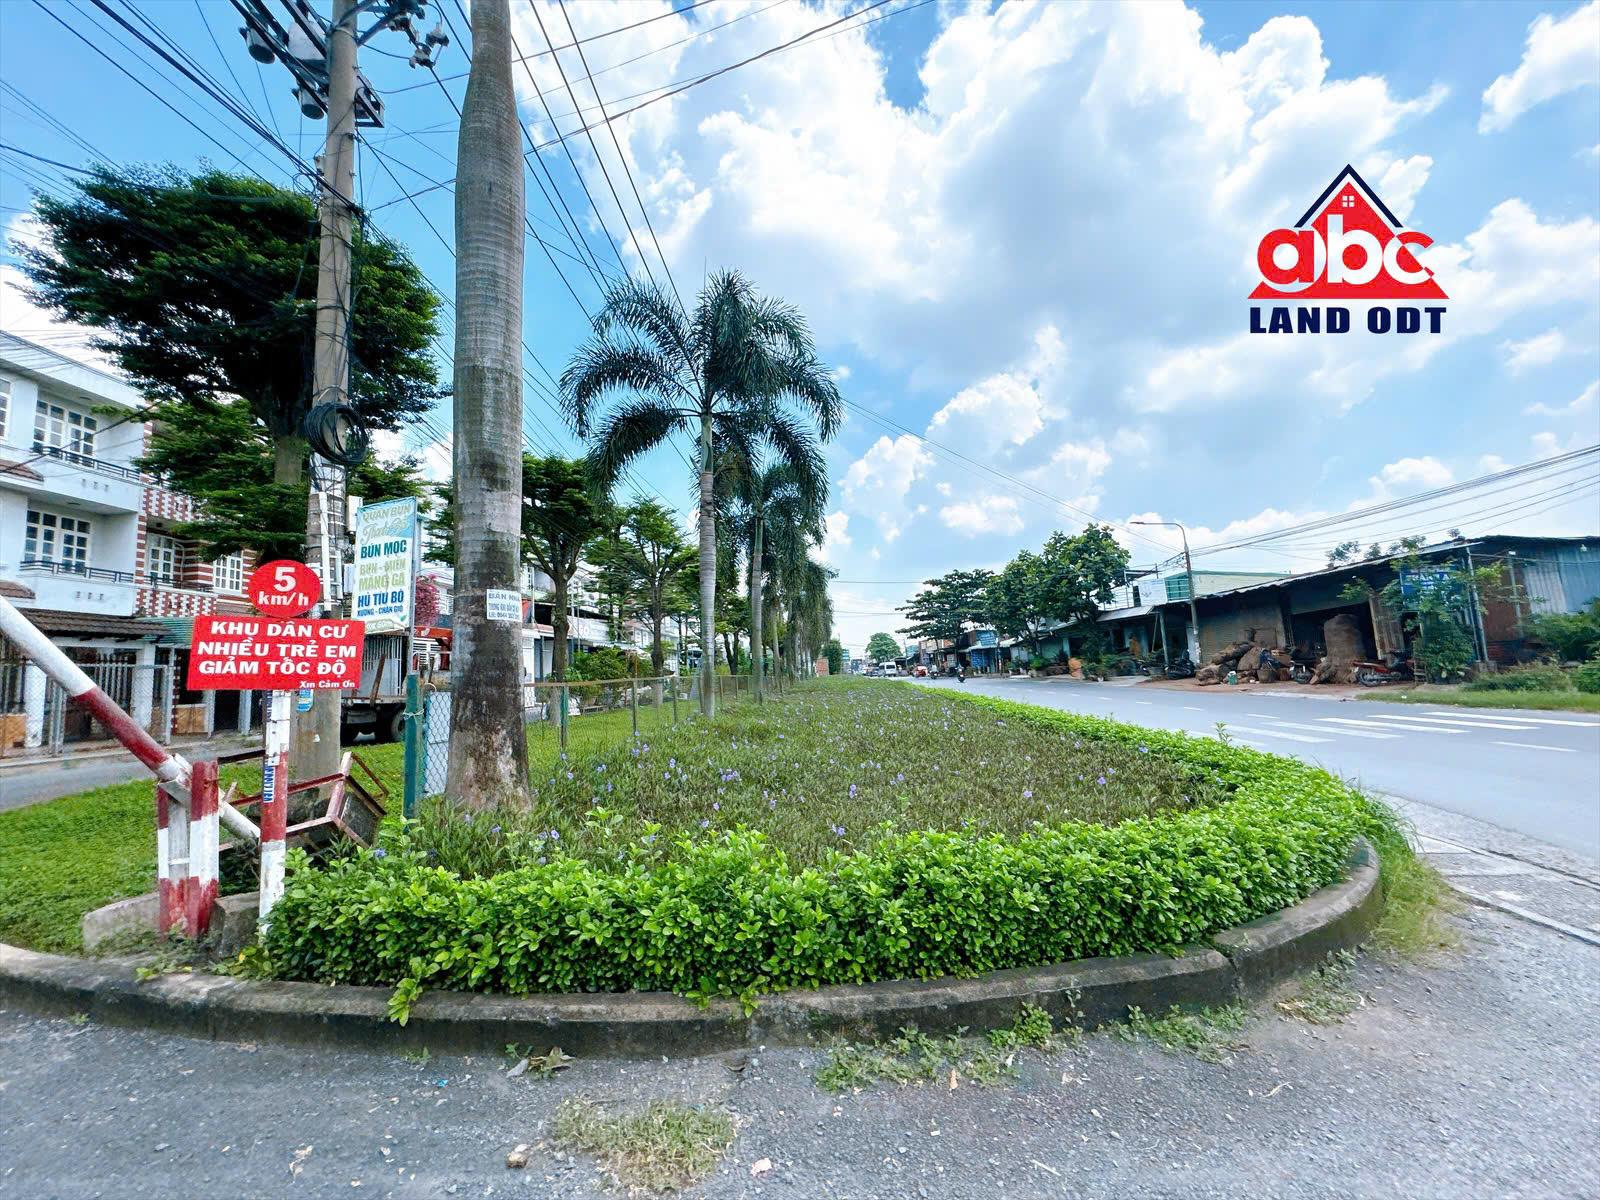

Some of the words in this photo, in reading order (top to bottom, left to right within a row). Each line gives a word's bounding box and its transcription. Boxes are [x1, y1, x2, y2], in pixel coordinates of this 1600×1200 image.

[361, 542, 382, 559] BÚN
[273, 566, 297, 592] 5
[258, 592, 309, 606] km/h
[211, 621, 259, 636] KHU
[266, 620, 313, 637] DÂN
[319, 624, 350, 639] CƯ
[197, 637, 270, 657] NHIỀU
[276, 639, 319, 658] TRẺ
[325, 645, 357, 658] EM
[198, 655, 259, 675] GIẢM
[266, 656, 311, 675] TỐC
[317, 659, 347, 678] ĐỘ
[299, 680, 316, 688] Xin
[318, 679, 340, 688] Cảm
